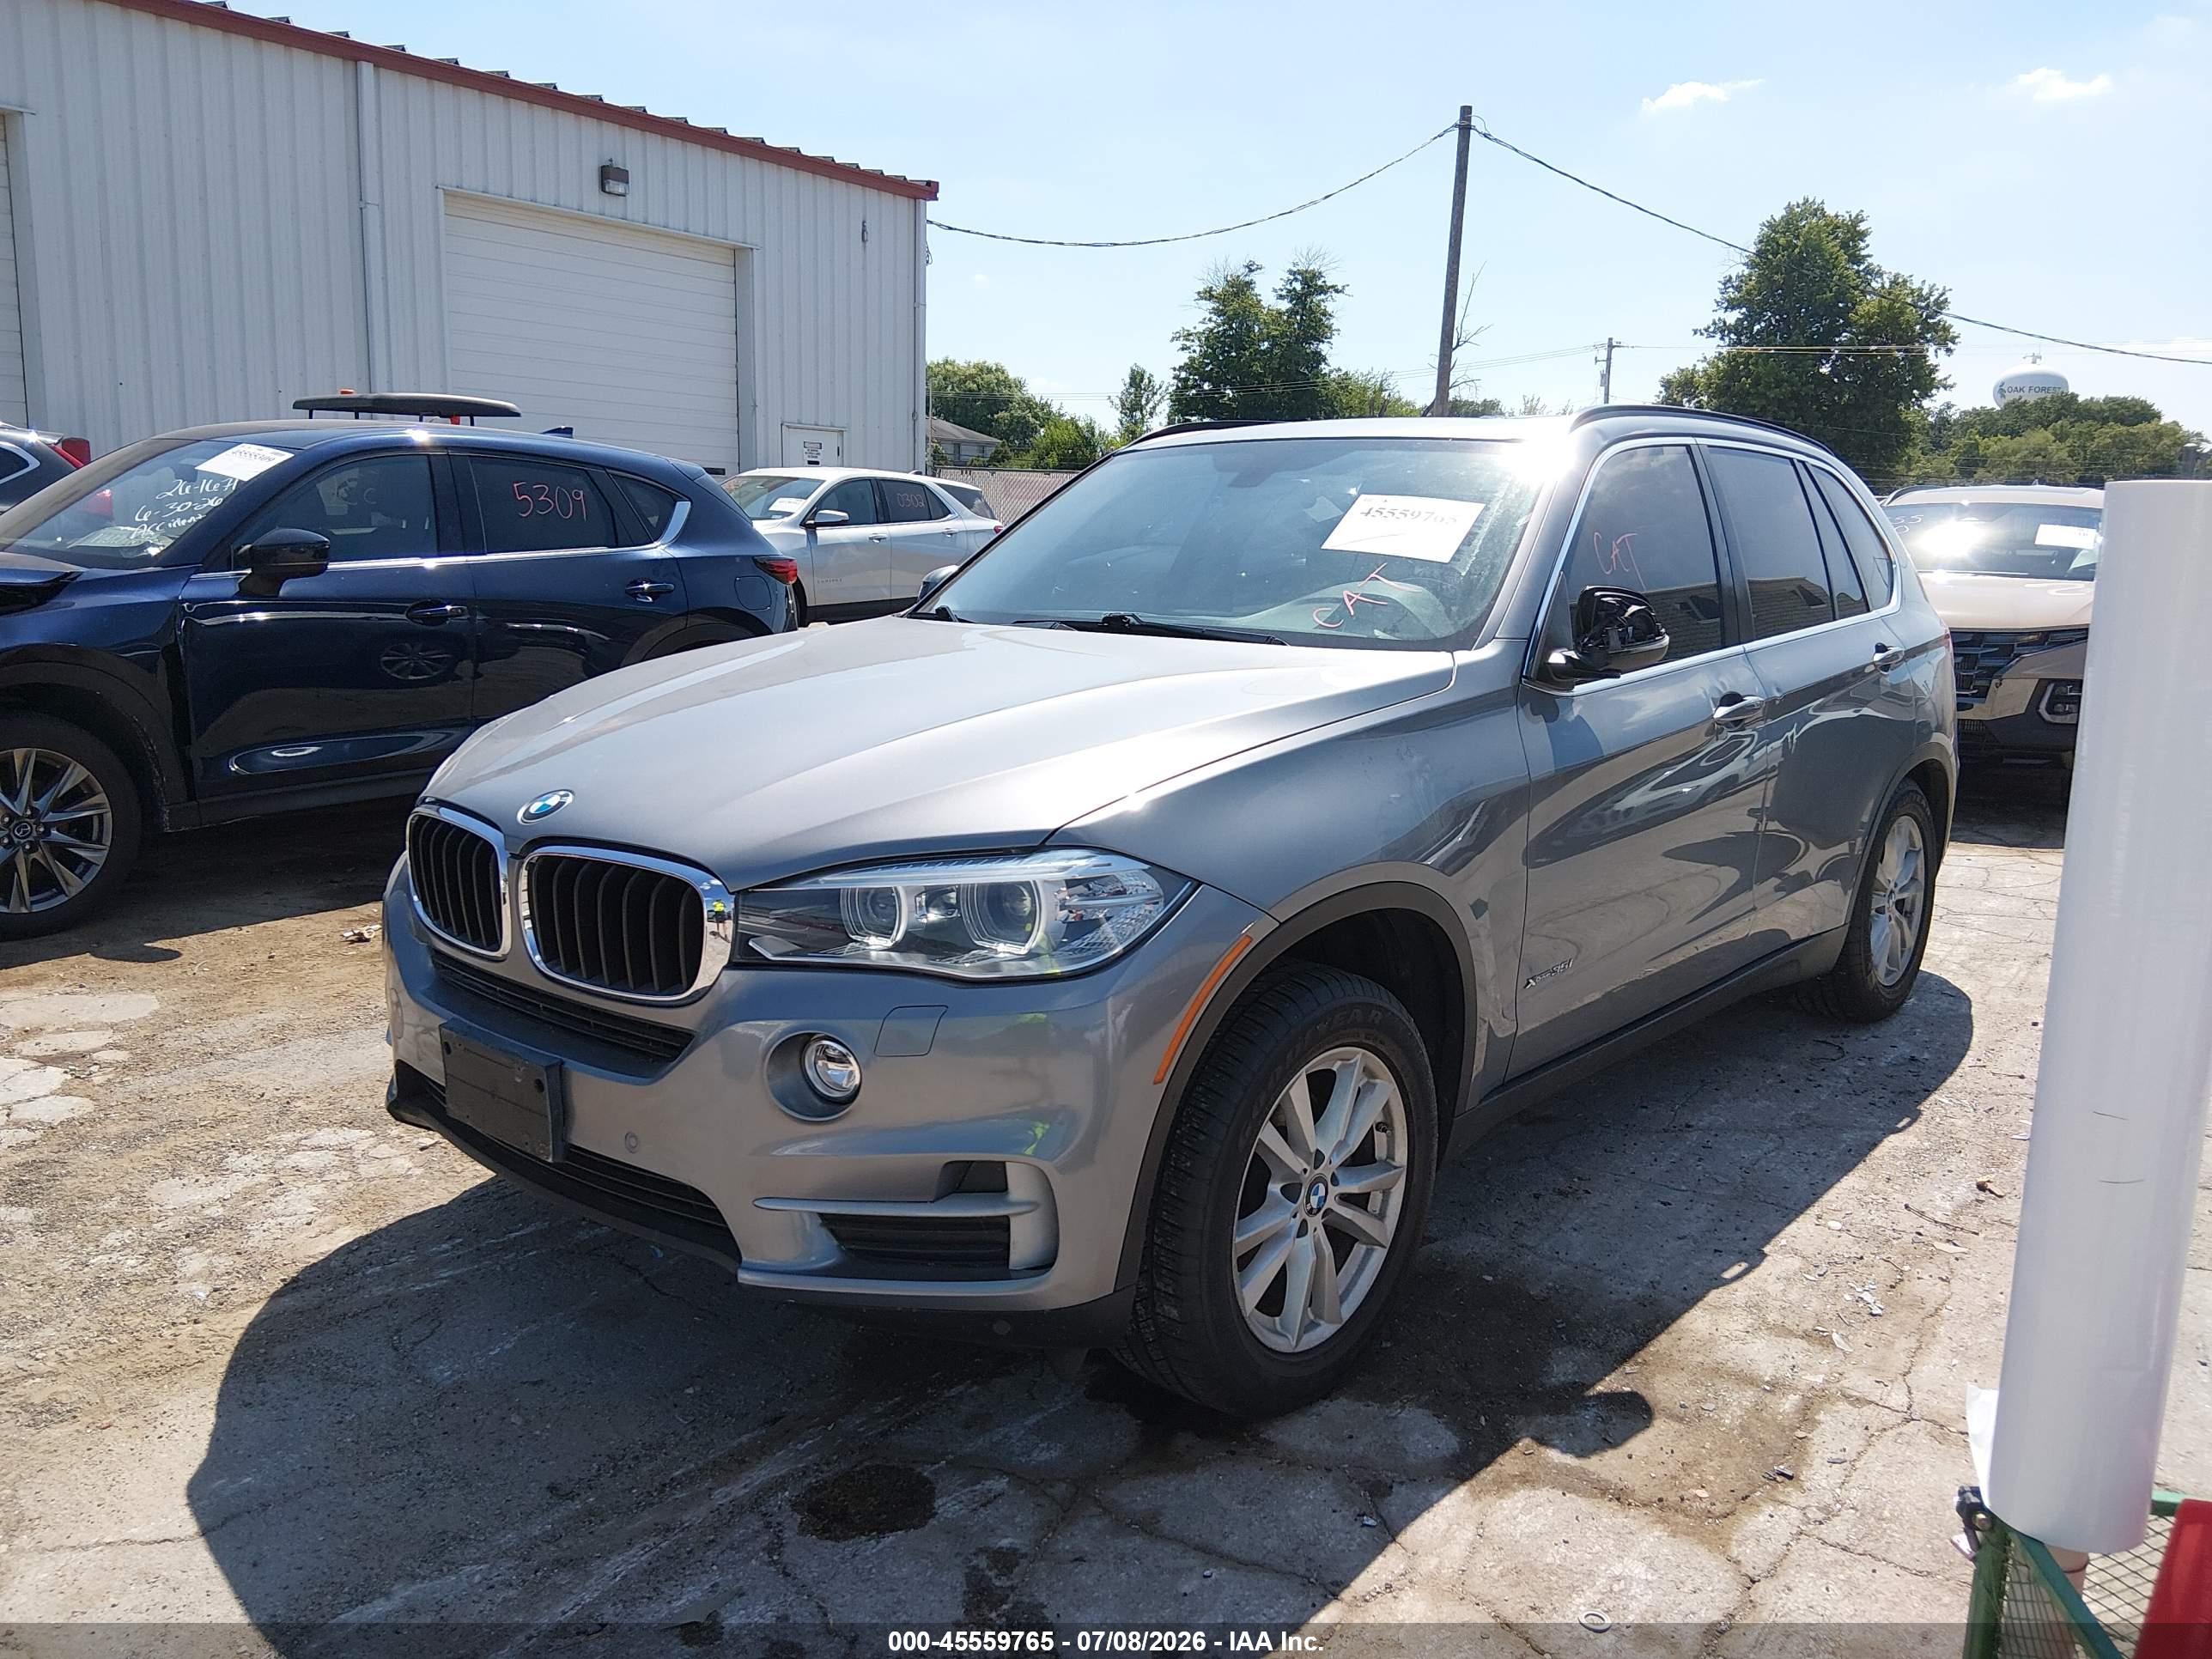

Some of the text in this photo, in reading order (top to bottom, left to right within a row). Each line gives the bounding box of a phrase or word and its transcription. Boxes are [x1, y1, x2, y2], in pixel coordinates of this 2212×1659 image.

[2006, 386, 2062, 395] OAK FOREST
[513, 481, 587, 522] 5309
[1594, 532, 1647, 592] CAT
[1312, 562, 1423, 629] CAT
